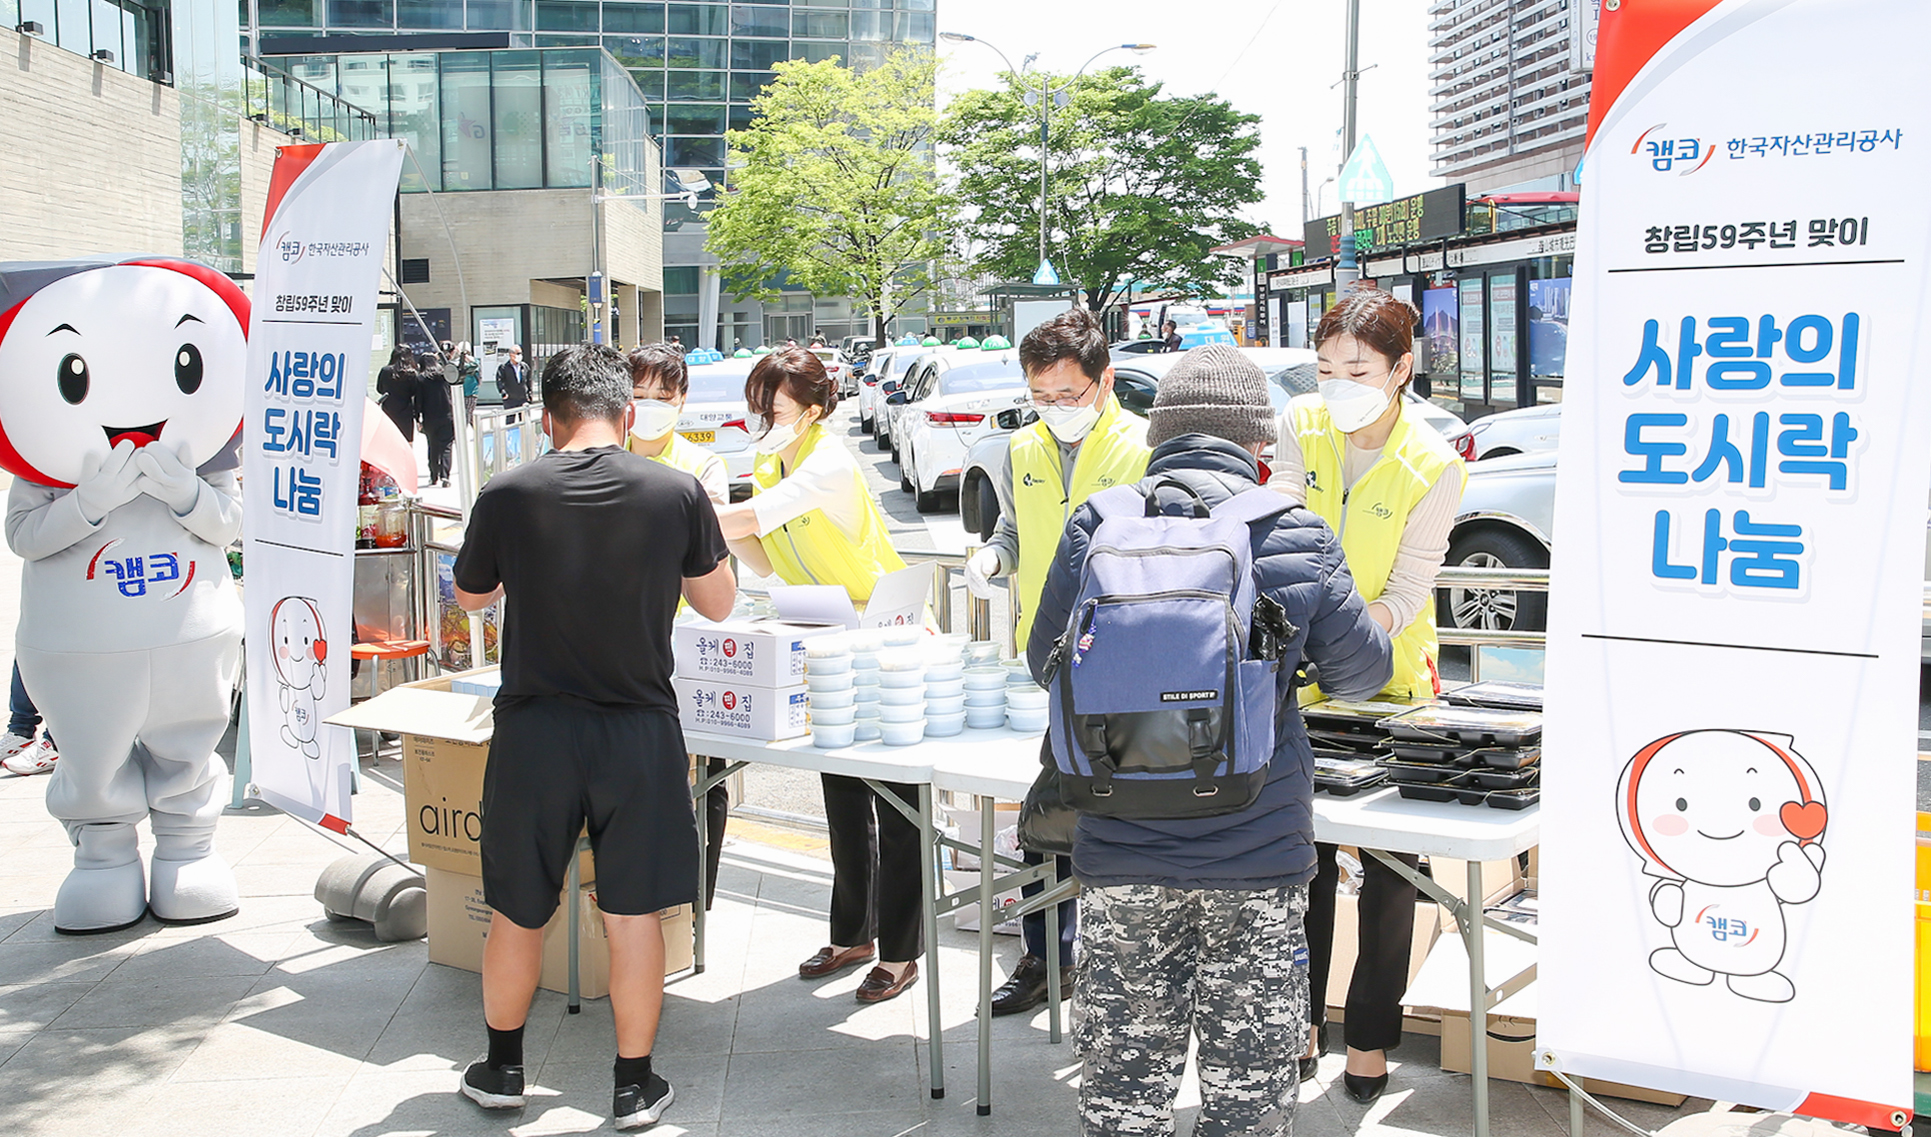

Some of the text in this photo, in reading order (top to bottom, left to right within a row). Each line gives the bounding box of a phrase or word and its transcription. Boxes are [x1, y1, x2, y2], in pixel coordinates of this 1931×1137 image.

[1646, 128, 1903, 172] 캠코 한국자산관리공사
[1406, 217, 1420, 240] 운행
[1410, 194, 1424, 220] 운행
[280, 241, 370, 261] 캠코 한국자산관리공사
[1644, 216, 1868, 254] 창립59주년 맞이
[275, 294, 353, 313] 창립59주년 맞이
[1622, 311, 1860, 390] 사랑의
[264, 350, 345, 400] 사랑의
[262, 407, 341, 459] 도시락
[1617, 411, 1858, 490] 도시락
[273, 466, 322, 516] 나눔
[1651, 508, 1805, 590] 나눔
[104, 552, 180, 597] 캠코
[1706, 915, 1747, 942] 캠코
